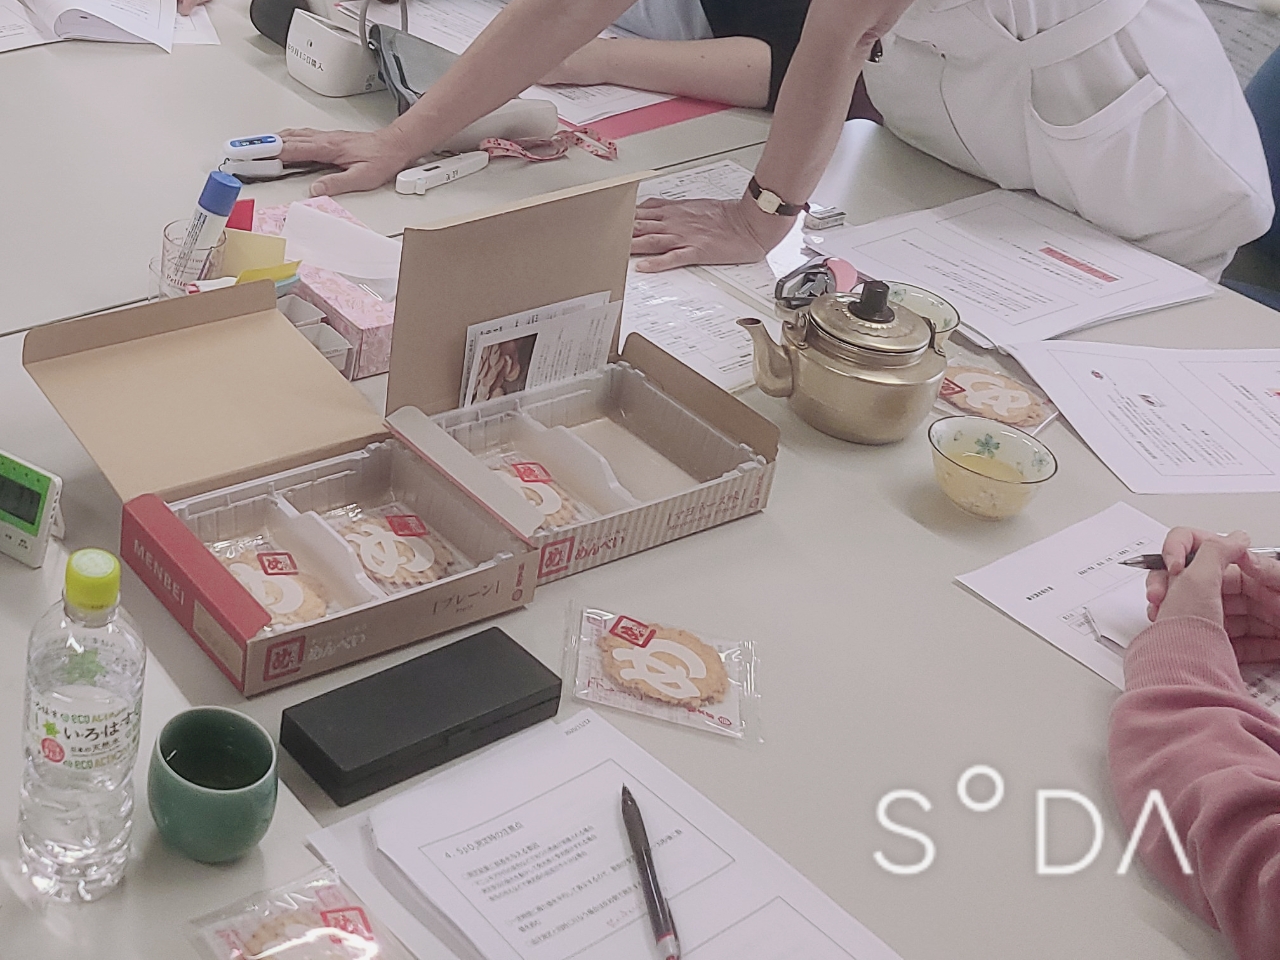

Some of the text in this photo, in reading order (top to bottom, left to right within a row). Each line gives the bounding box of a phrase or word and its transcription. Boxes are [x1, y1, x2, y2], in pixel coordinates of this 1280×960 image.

[575, 536, 625, 560] めんべい
[132, 539, 186, 607] MENBEI
